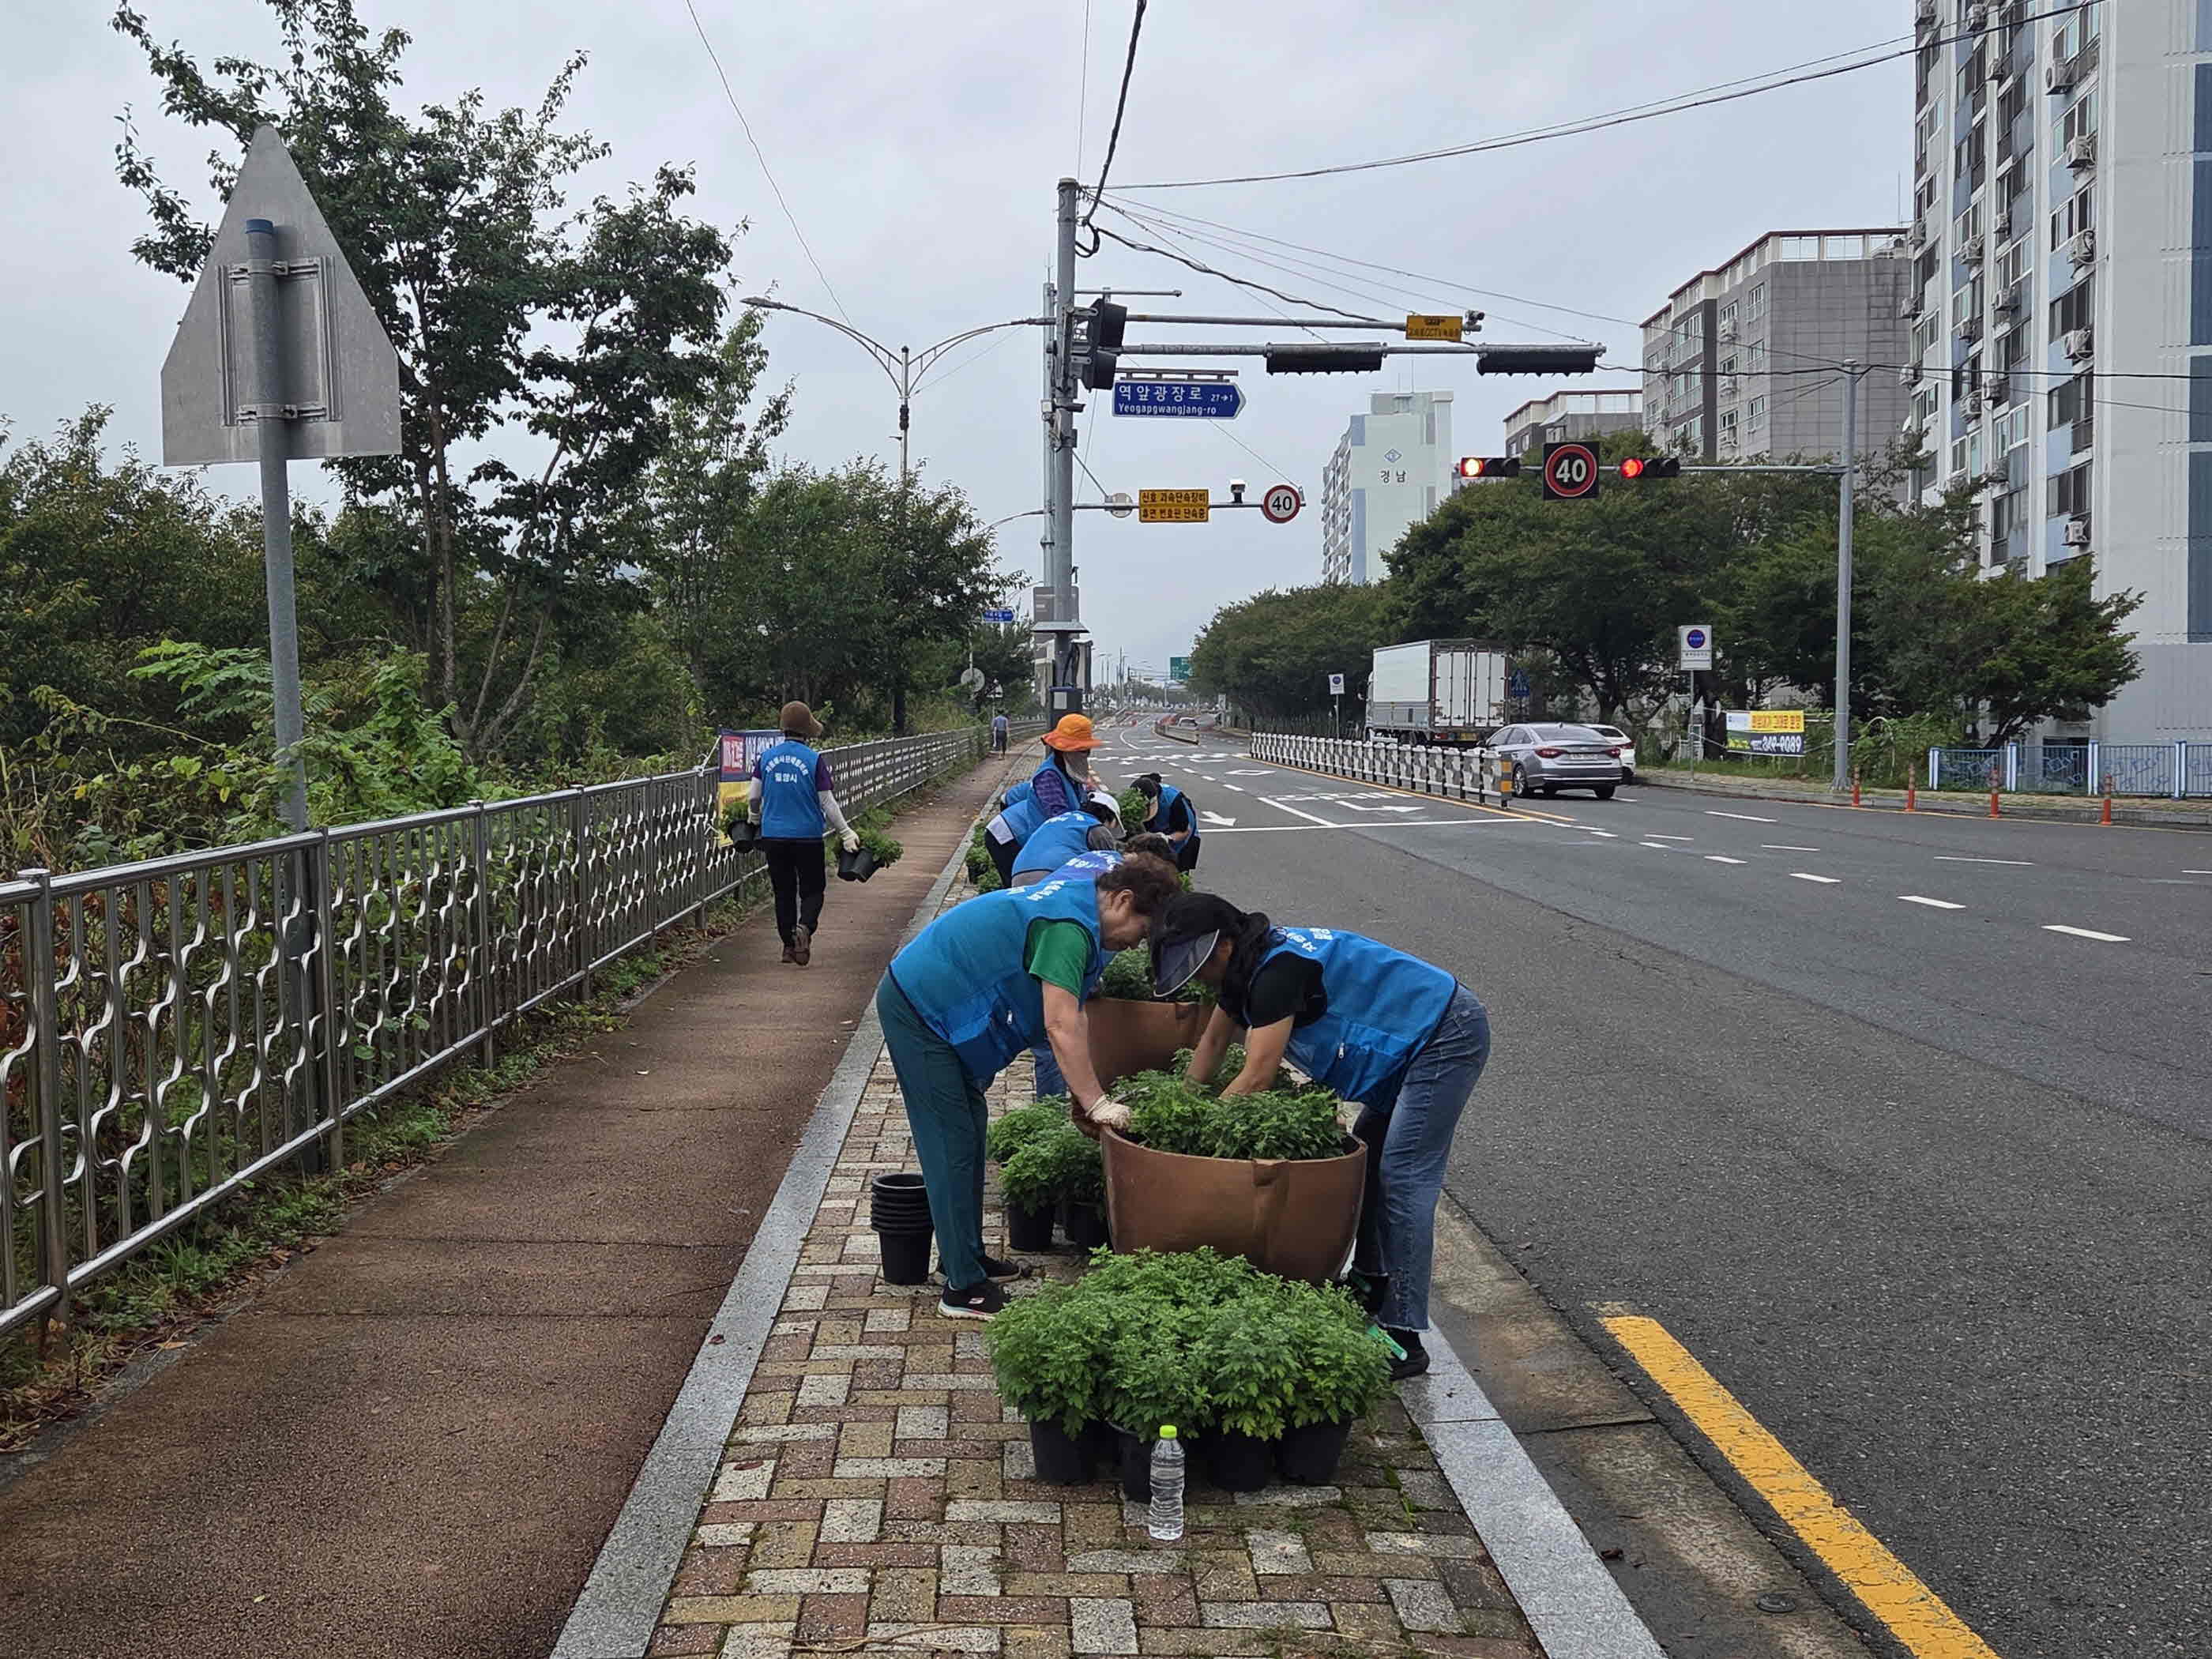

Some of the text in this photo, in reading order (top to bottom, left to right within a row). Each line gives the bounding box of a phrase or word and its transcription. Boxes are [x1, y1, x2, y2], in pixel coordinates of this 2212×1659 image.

[1119, 385, 1203, 402] 역앞광장로
[1119, 403, 1217, 416] Yeogapgwangjang-ro
[1380, 470, 1406, 483] 경남
[1556, 459, 1587, 483] 40
[1271, 495, 1292, 511] 40
